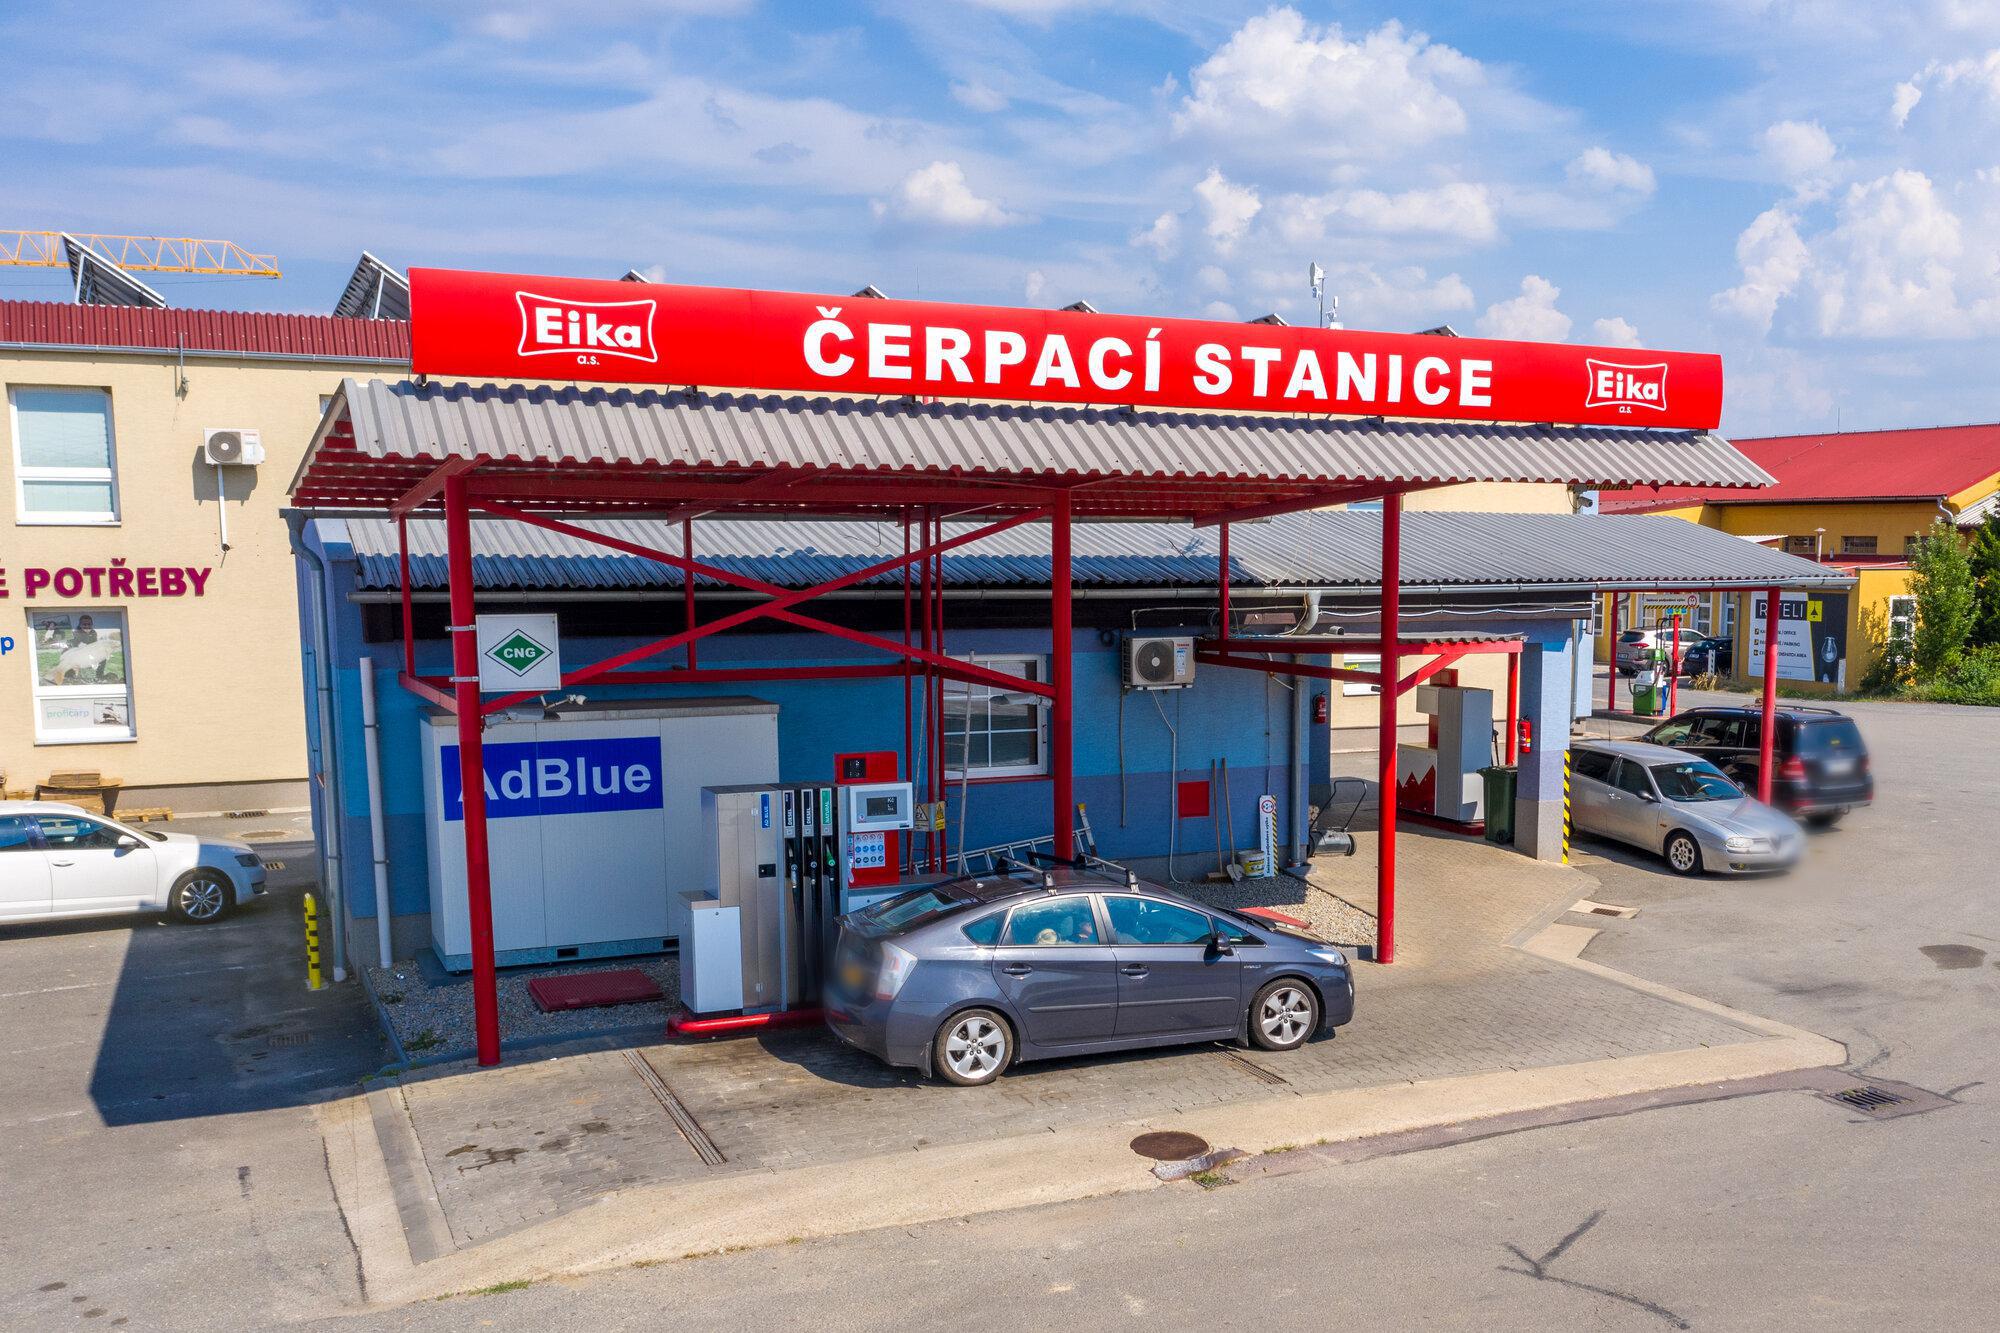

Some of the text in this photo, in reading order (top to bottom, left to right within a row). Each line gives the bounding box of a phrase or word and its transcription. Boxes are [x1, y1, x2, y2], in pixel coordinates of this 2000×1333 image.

[535, 306, 642, 349] Eika
[576, 354, 600, 366] a.s.
[803, 305, 1493, 408] ČERPACÍ STANICE
[1597, 370, 1659, 401] Eika
[24, 557, 212, 599] POTŘEBY
[503, 647, 536, 659] CNG
